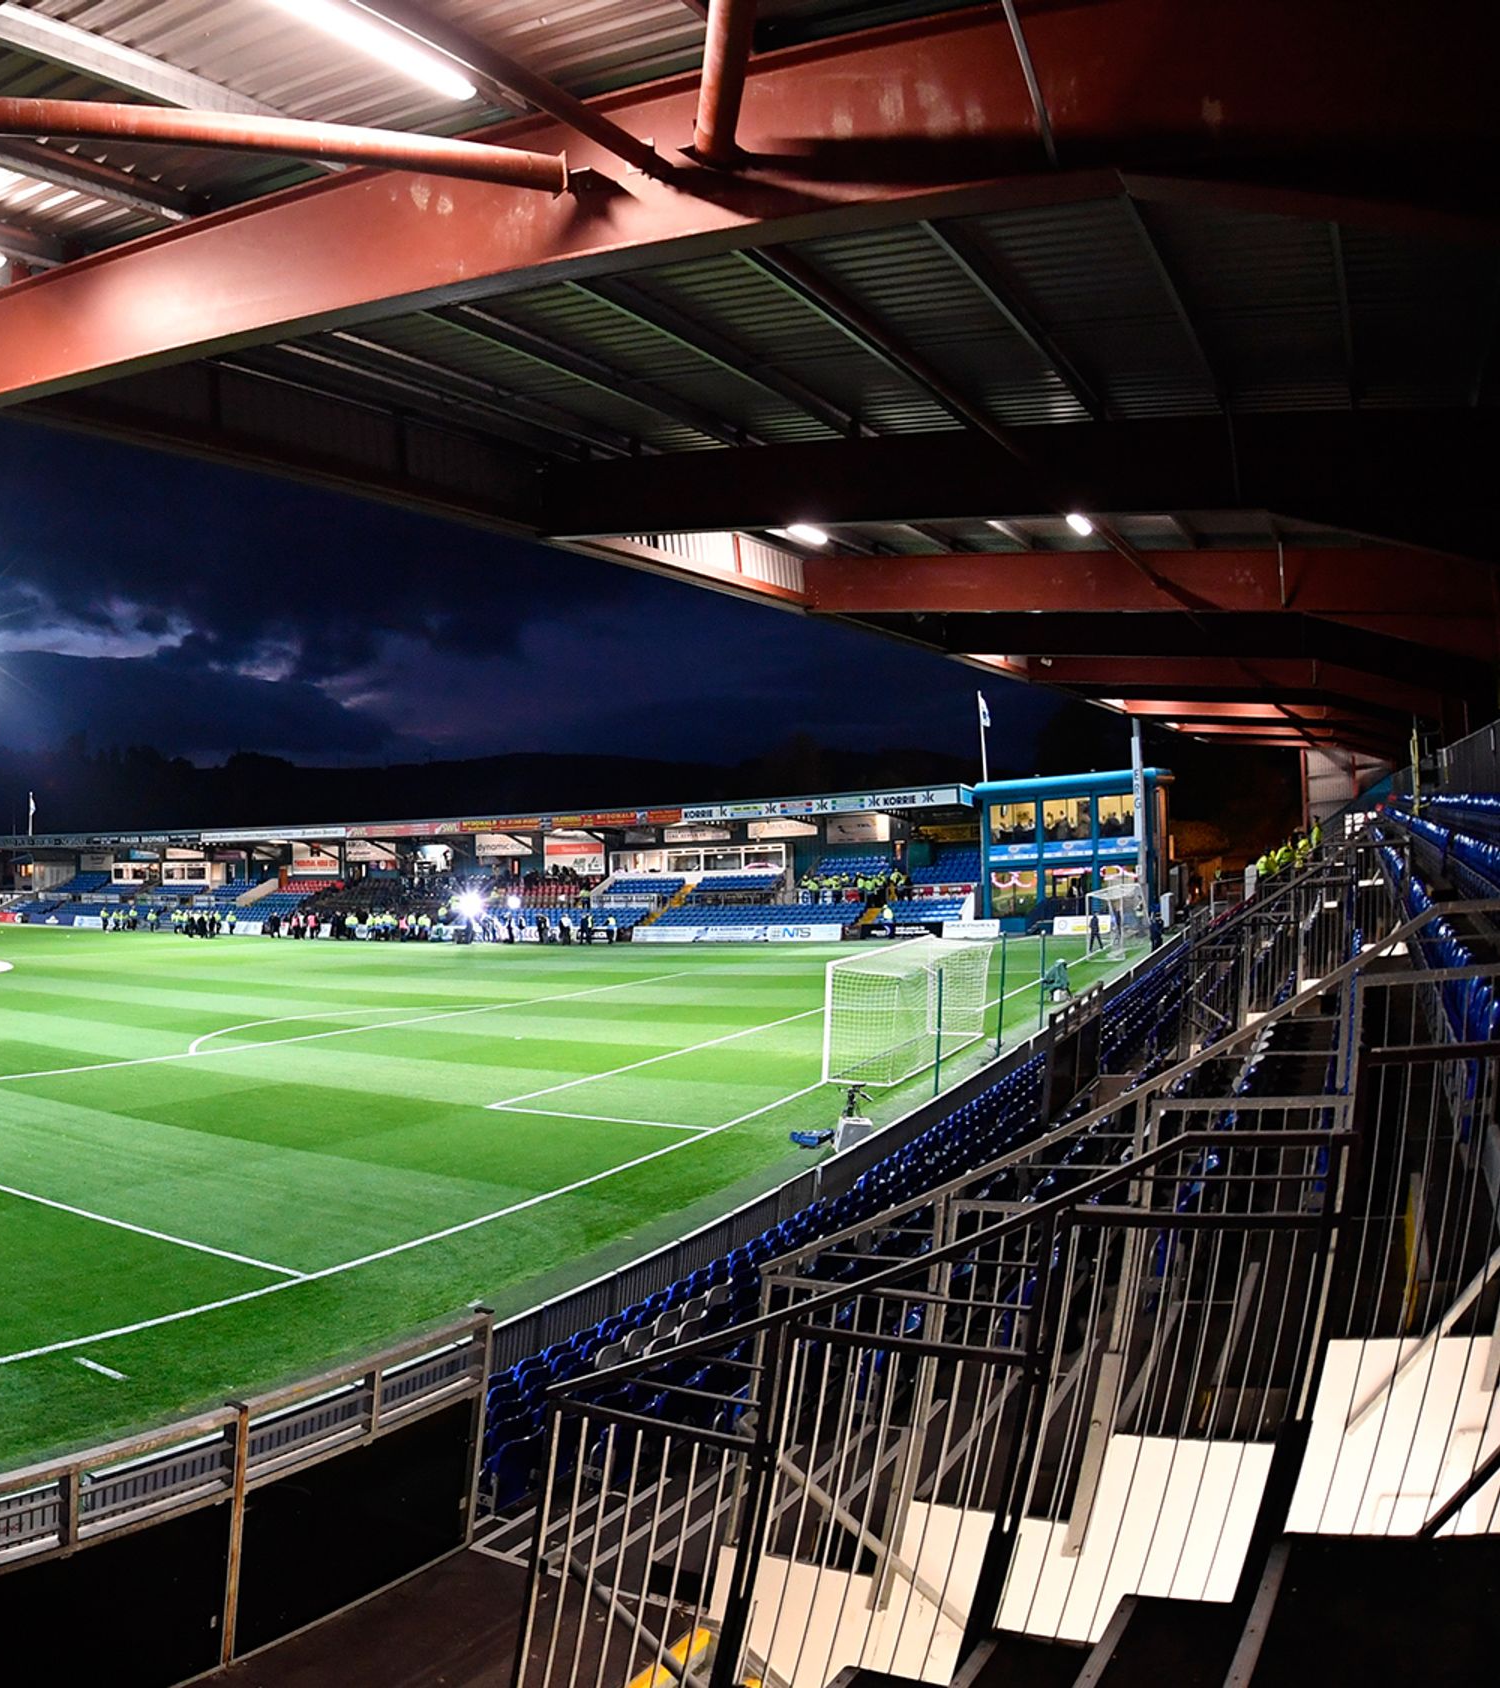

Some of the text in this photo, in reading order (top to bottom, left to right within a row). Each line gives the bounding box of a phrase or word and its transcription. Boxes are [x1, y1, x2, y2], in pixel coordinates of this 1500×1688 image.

[882, 795, 917, 806] KORRIE
[684, 809, 713, 819] KORRIE
[782, 926, 811, 938] NTS
